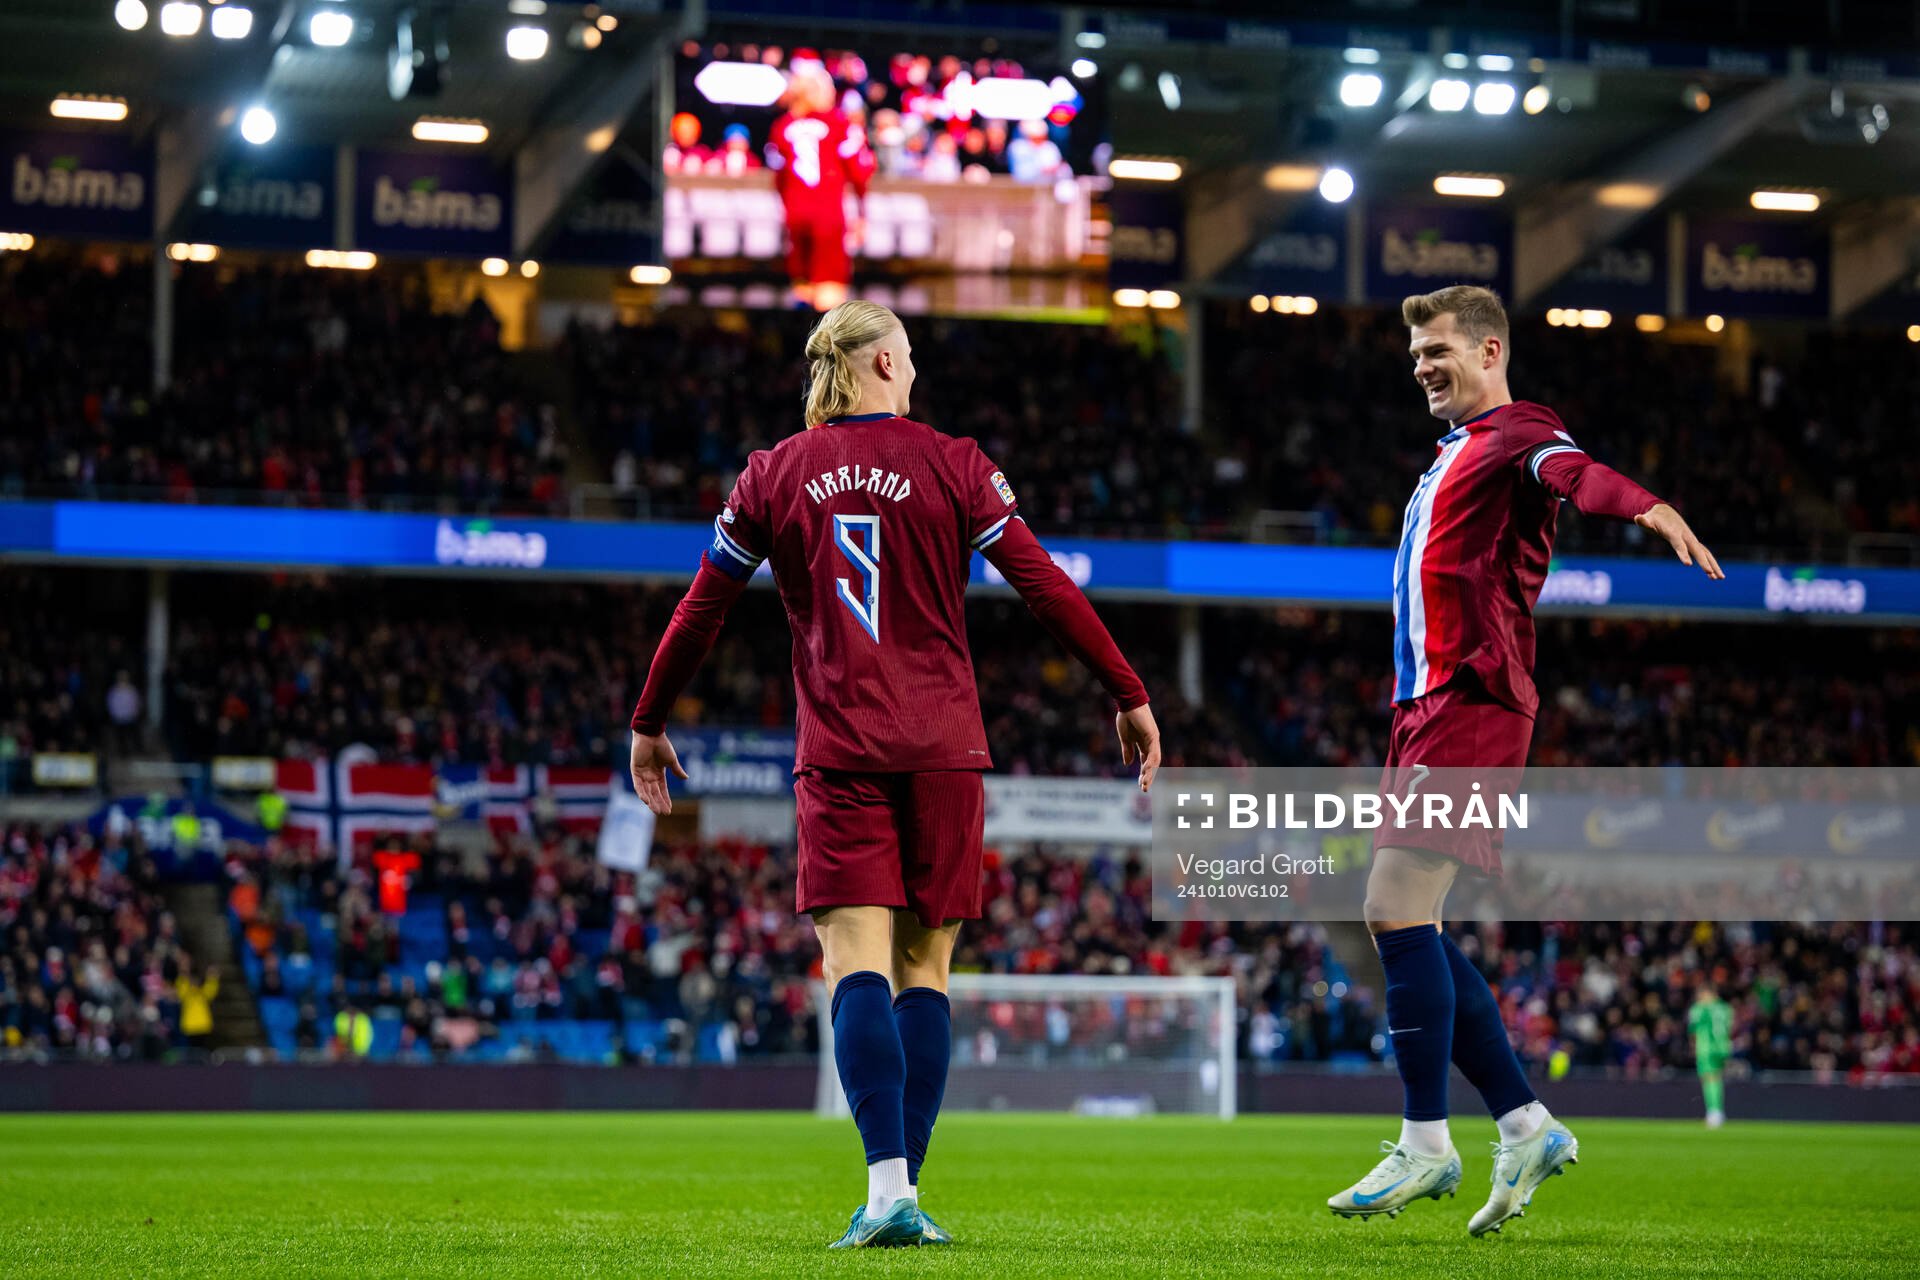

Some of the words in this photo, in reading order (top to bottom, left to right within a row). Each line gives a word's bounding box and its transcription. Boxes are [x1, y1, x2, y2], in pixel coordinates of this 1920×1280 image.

[804, 463, 912, 505] HAALAND
[833, 514, 880, 645] 9
[1407, 764, 1430, 797] 7
